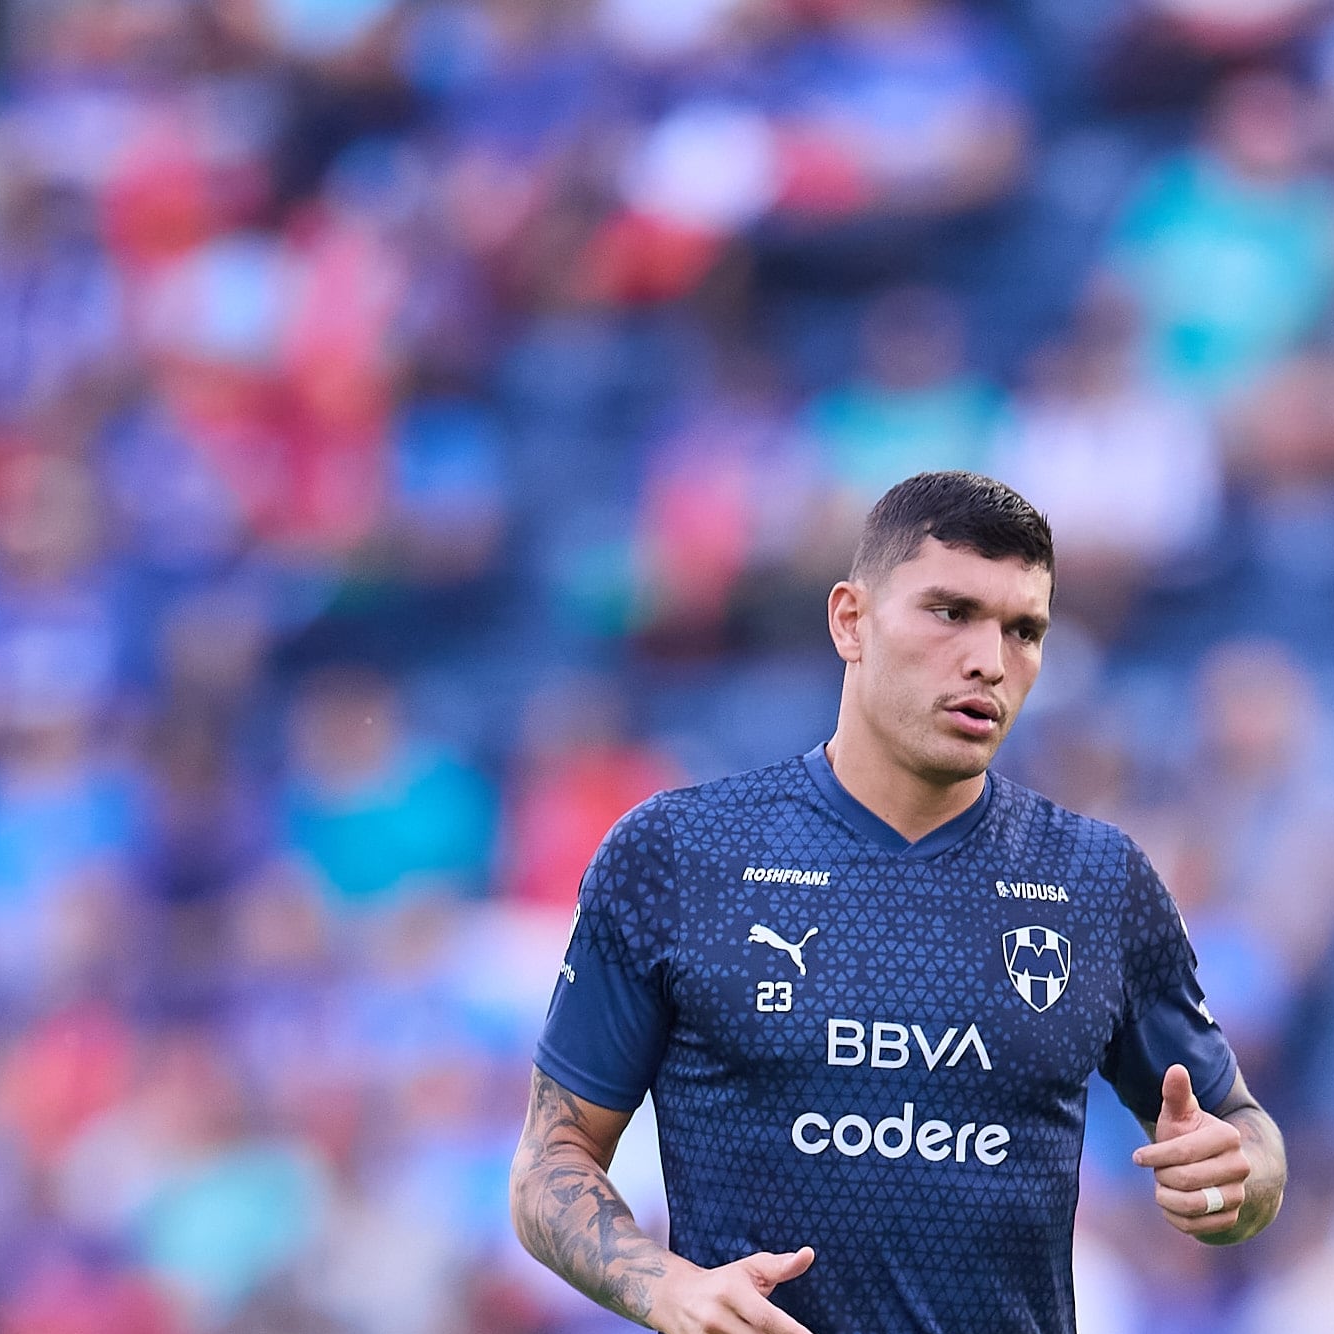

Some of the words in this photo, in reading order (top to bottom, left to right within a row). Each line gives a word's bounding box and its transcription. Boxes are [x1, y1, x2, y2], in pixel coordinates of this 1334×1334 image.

[742, 866, 831, 887] ROSHFRANS
[1009, 882, 1070, 902] VIDUSA
[756, 981, 793, 1012] 23
[827, 1018, 993, 1072] BBVA
[791, 1102, 1011, 1166] codere
